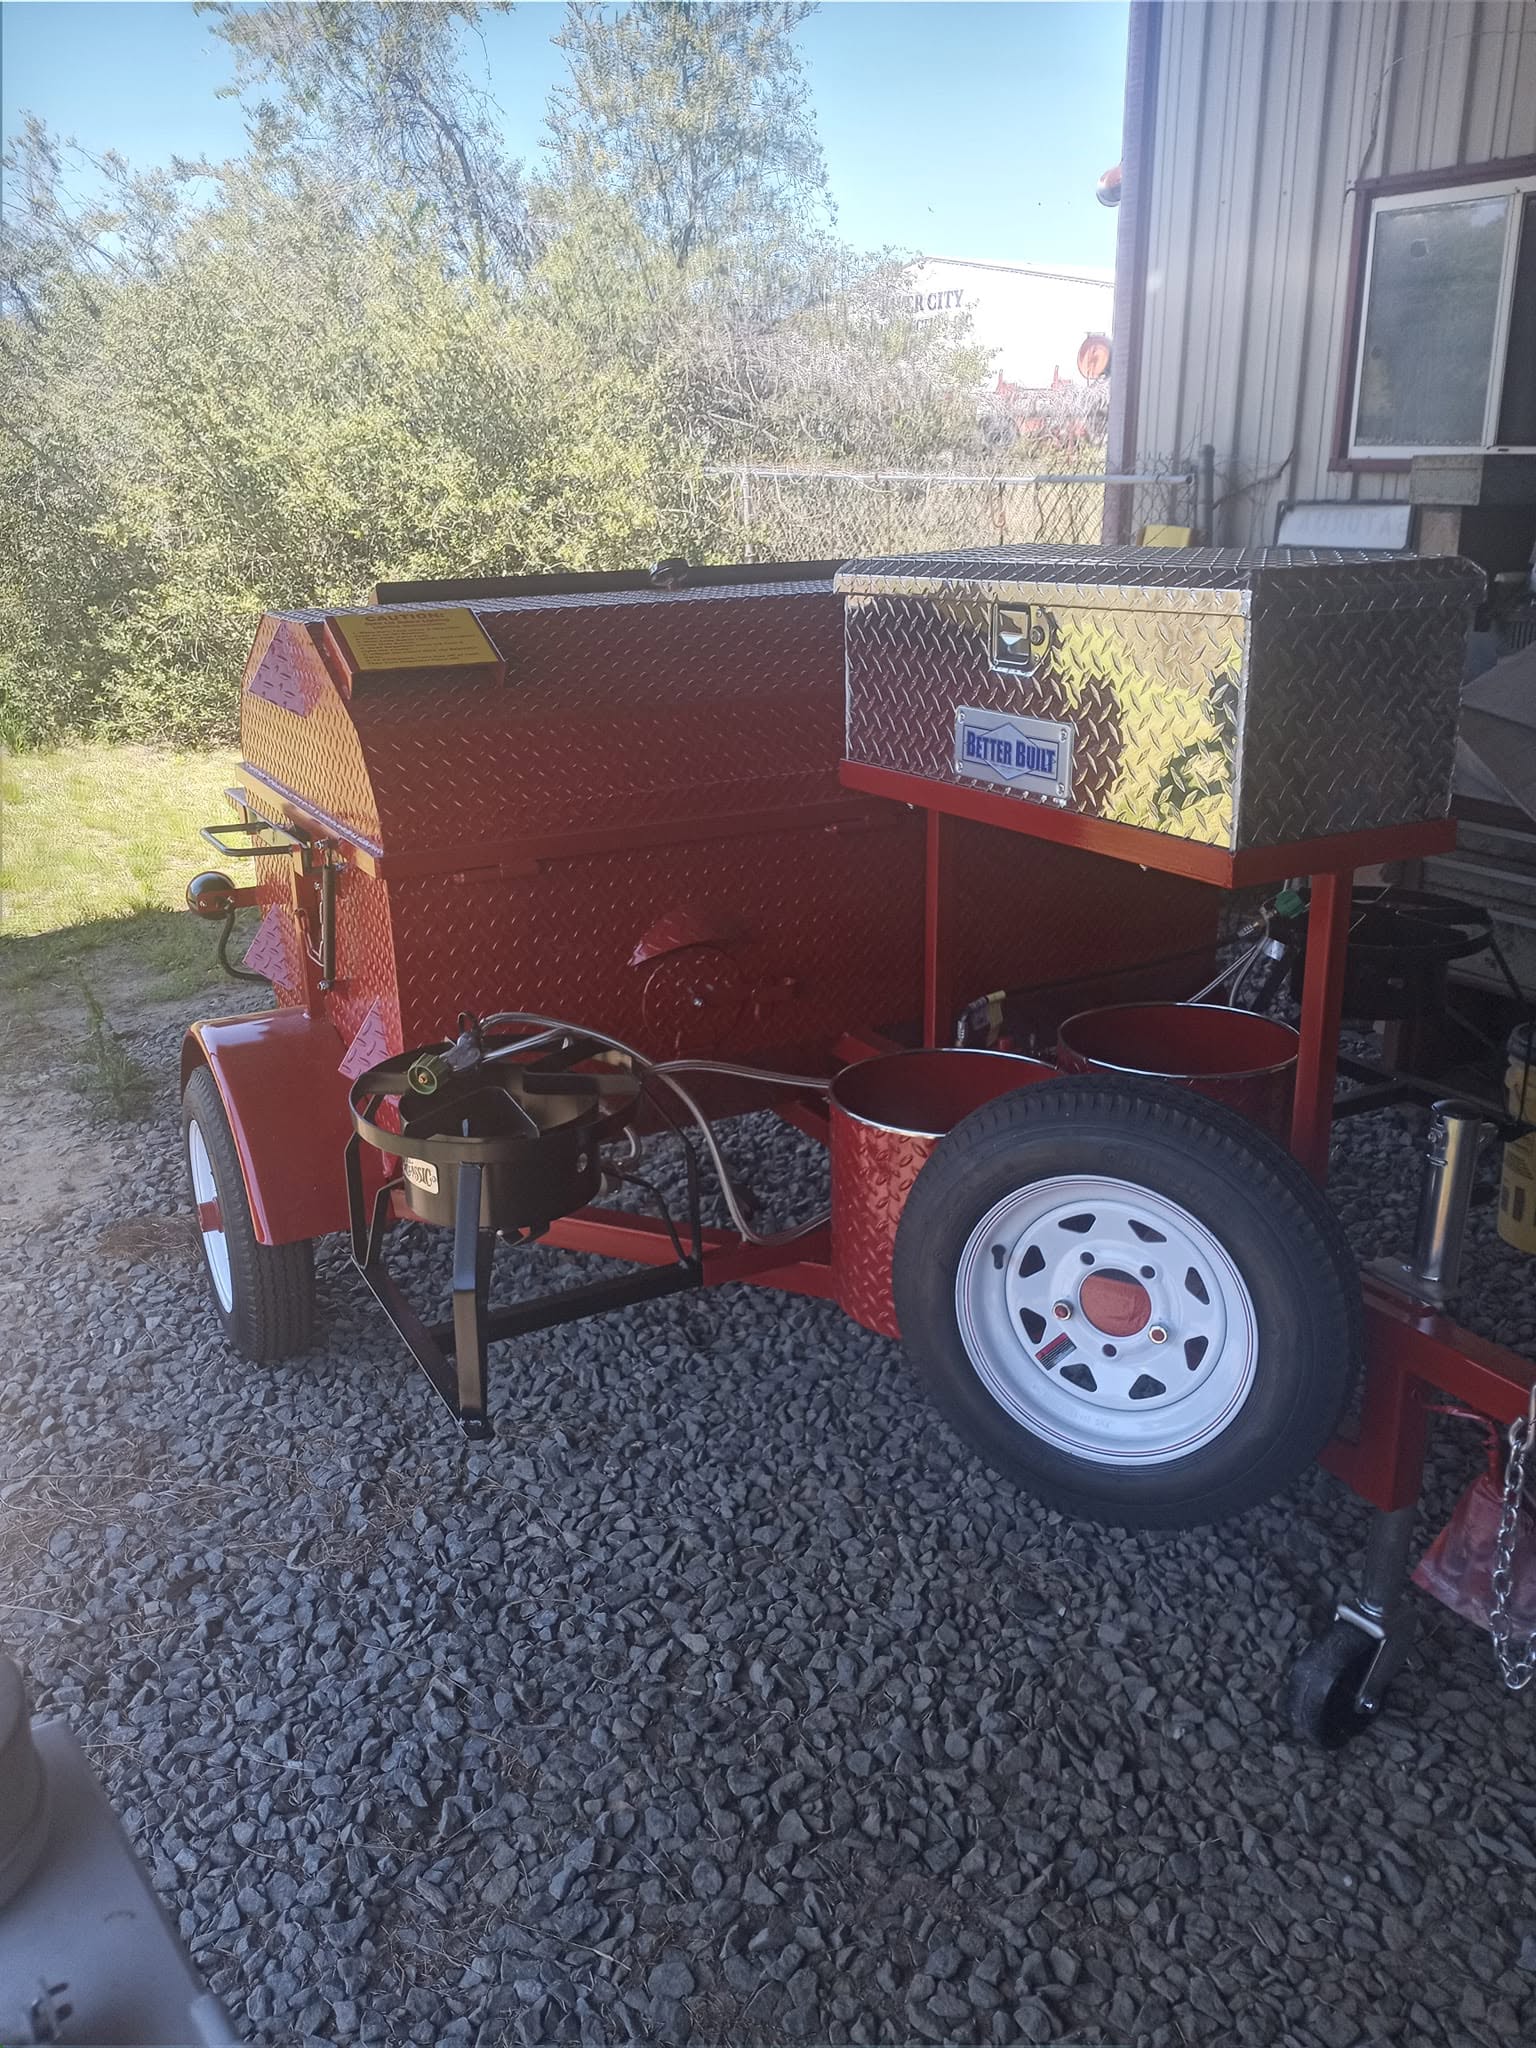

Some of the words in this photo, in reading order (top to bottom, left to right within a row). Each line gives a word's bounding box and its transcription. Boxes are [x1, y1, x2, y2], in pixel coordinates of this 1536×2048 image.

[927, 289, 964, 311] CITY
[966, 730, 1012, 766] BETTER
[1015, 739, 1057, 774] BUILT
